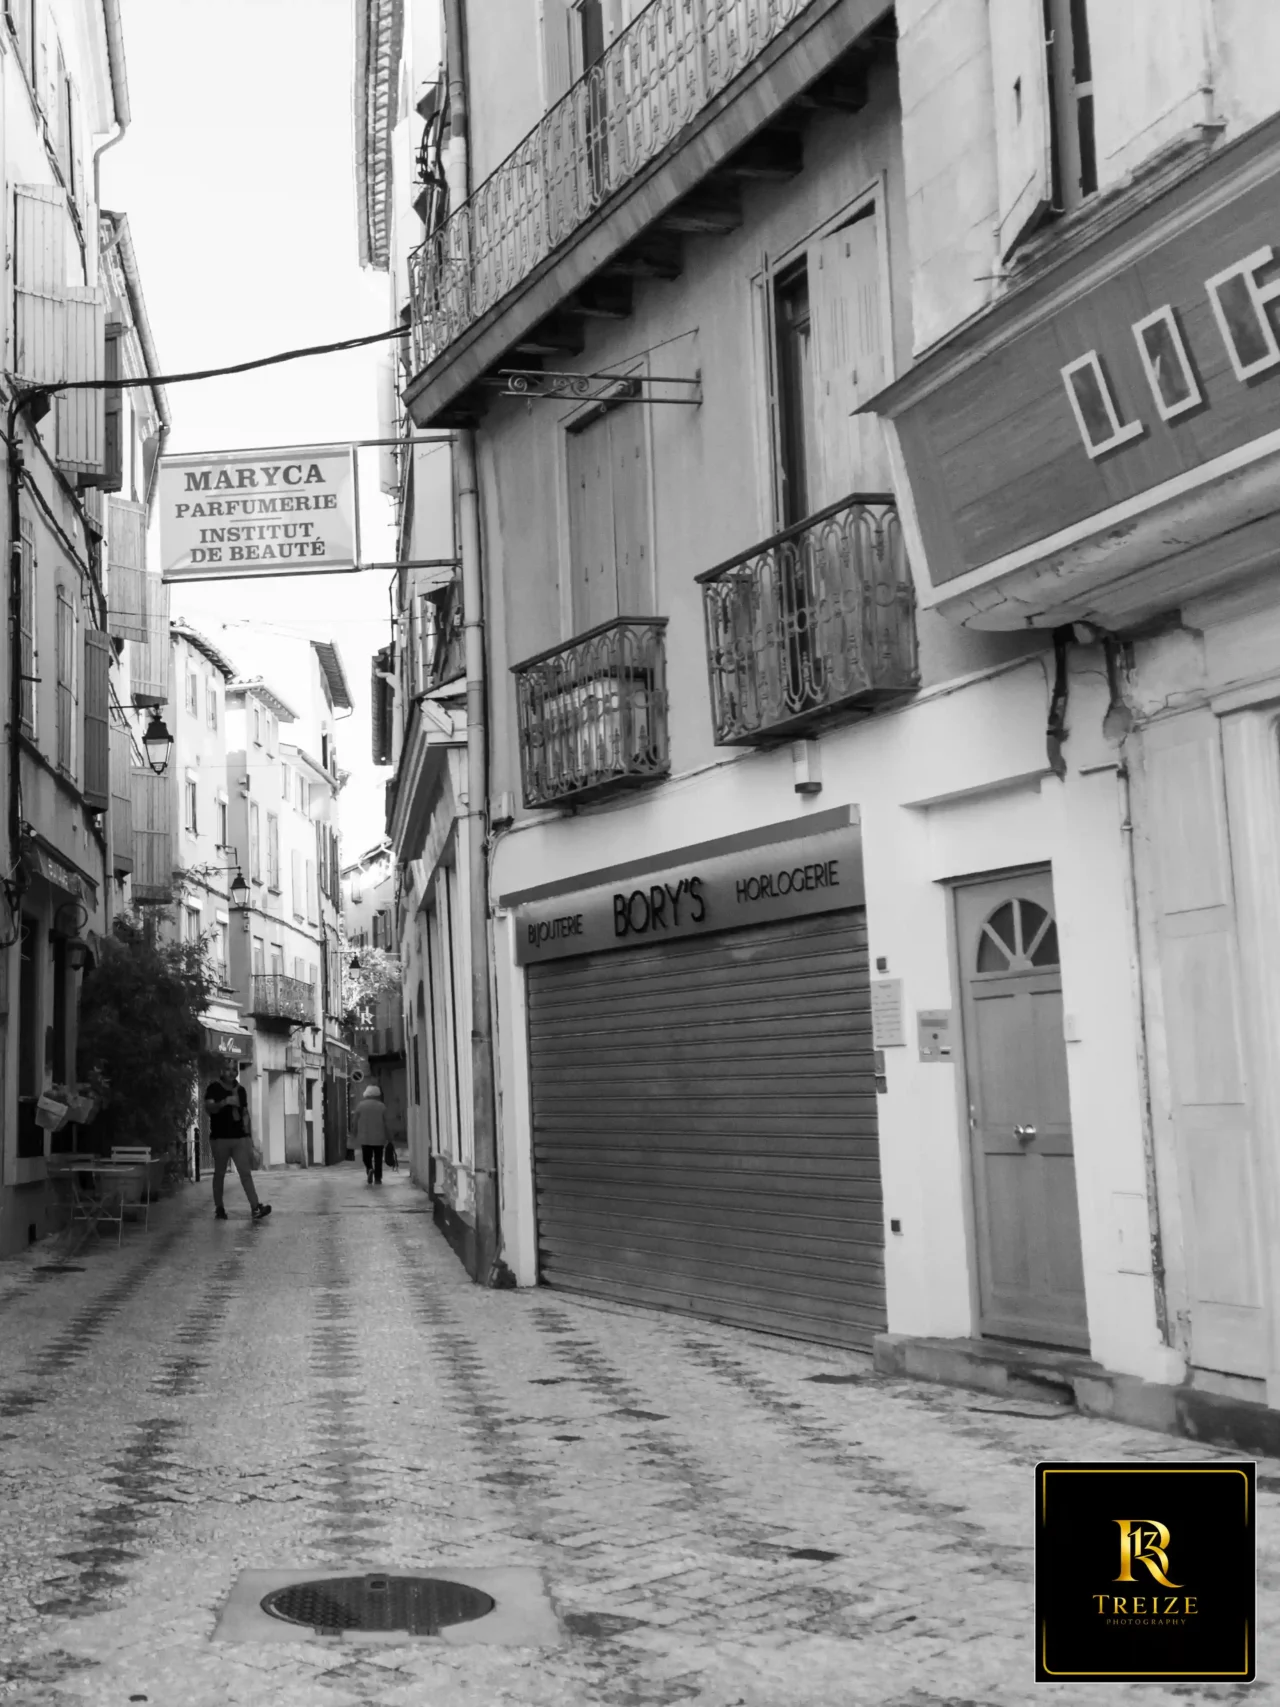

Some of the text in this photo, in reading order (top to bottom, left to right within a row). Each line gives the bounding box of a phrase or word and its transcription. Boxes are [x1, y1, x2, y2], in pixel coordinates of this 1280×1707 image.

[184, 464, 326, 492] MARYCA
[175, 494, 337, 519] PARFUMERIE
[199, 522, 314, 544] INSTITUT
[190, 537, 326, 563] DE BEAUTÉ
[527, 860, 840, 949] BIJOUTERIE BORY'S HORLOGERIE
